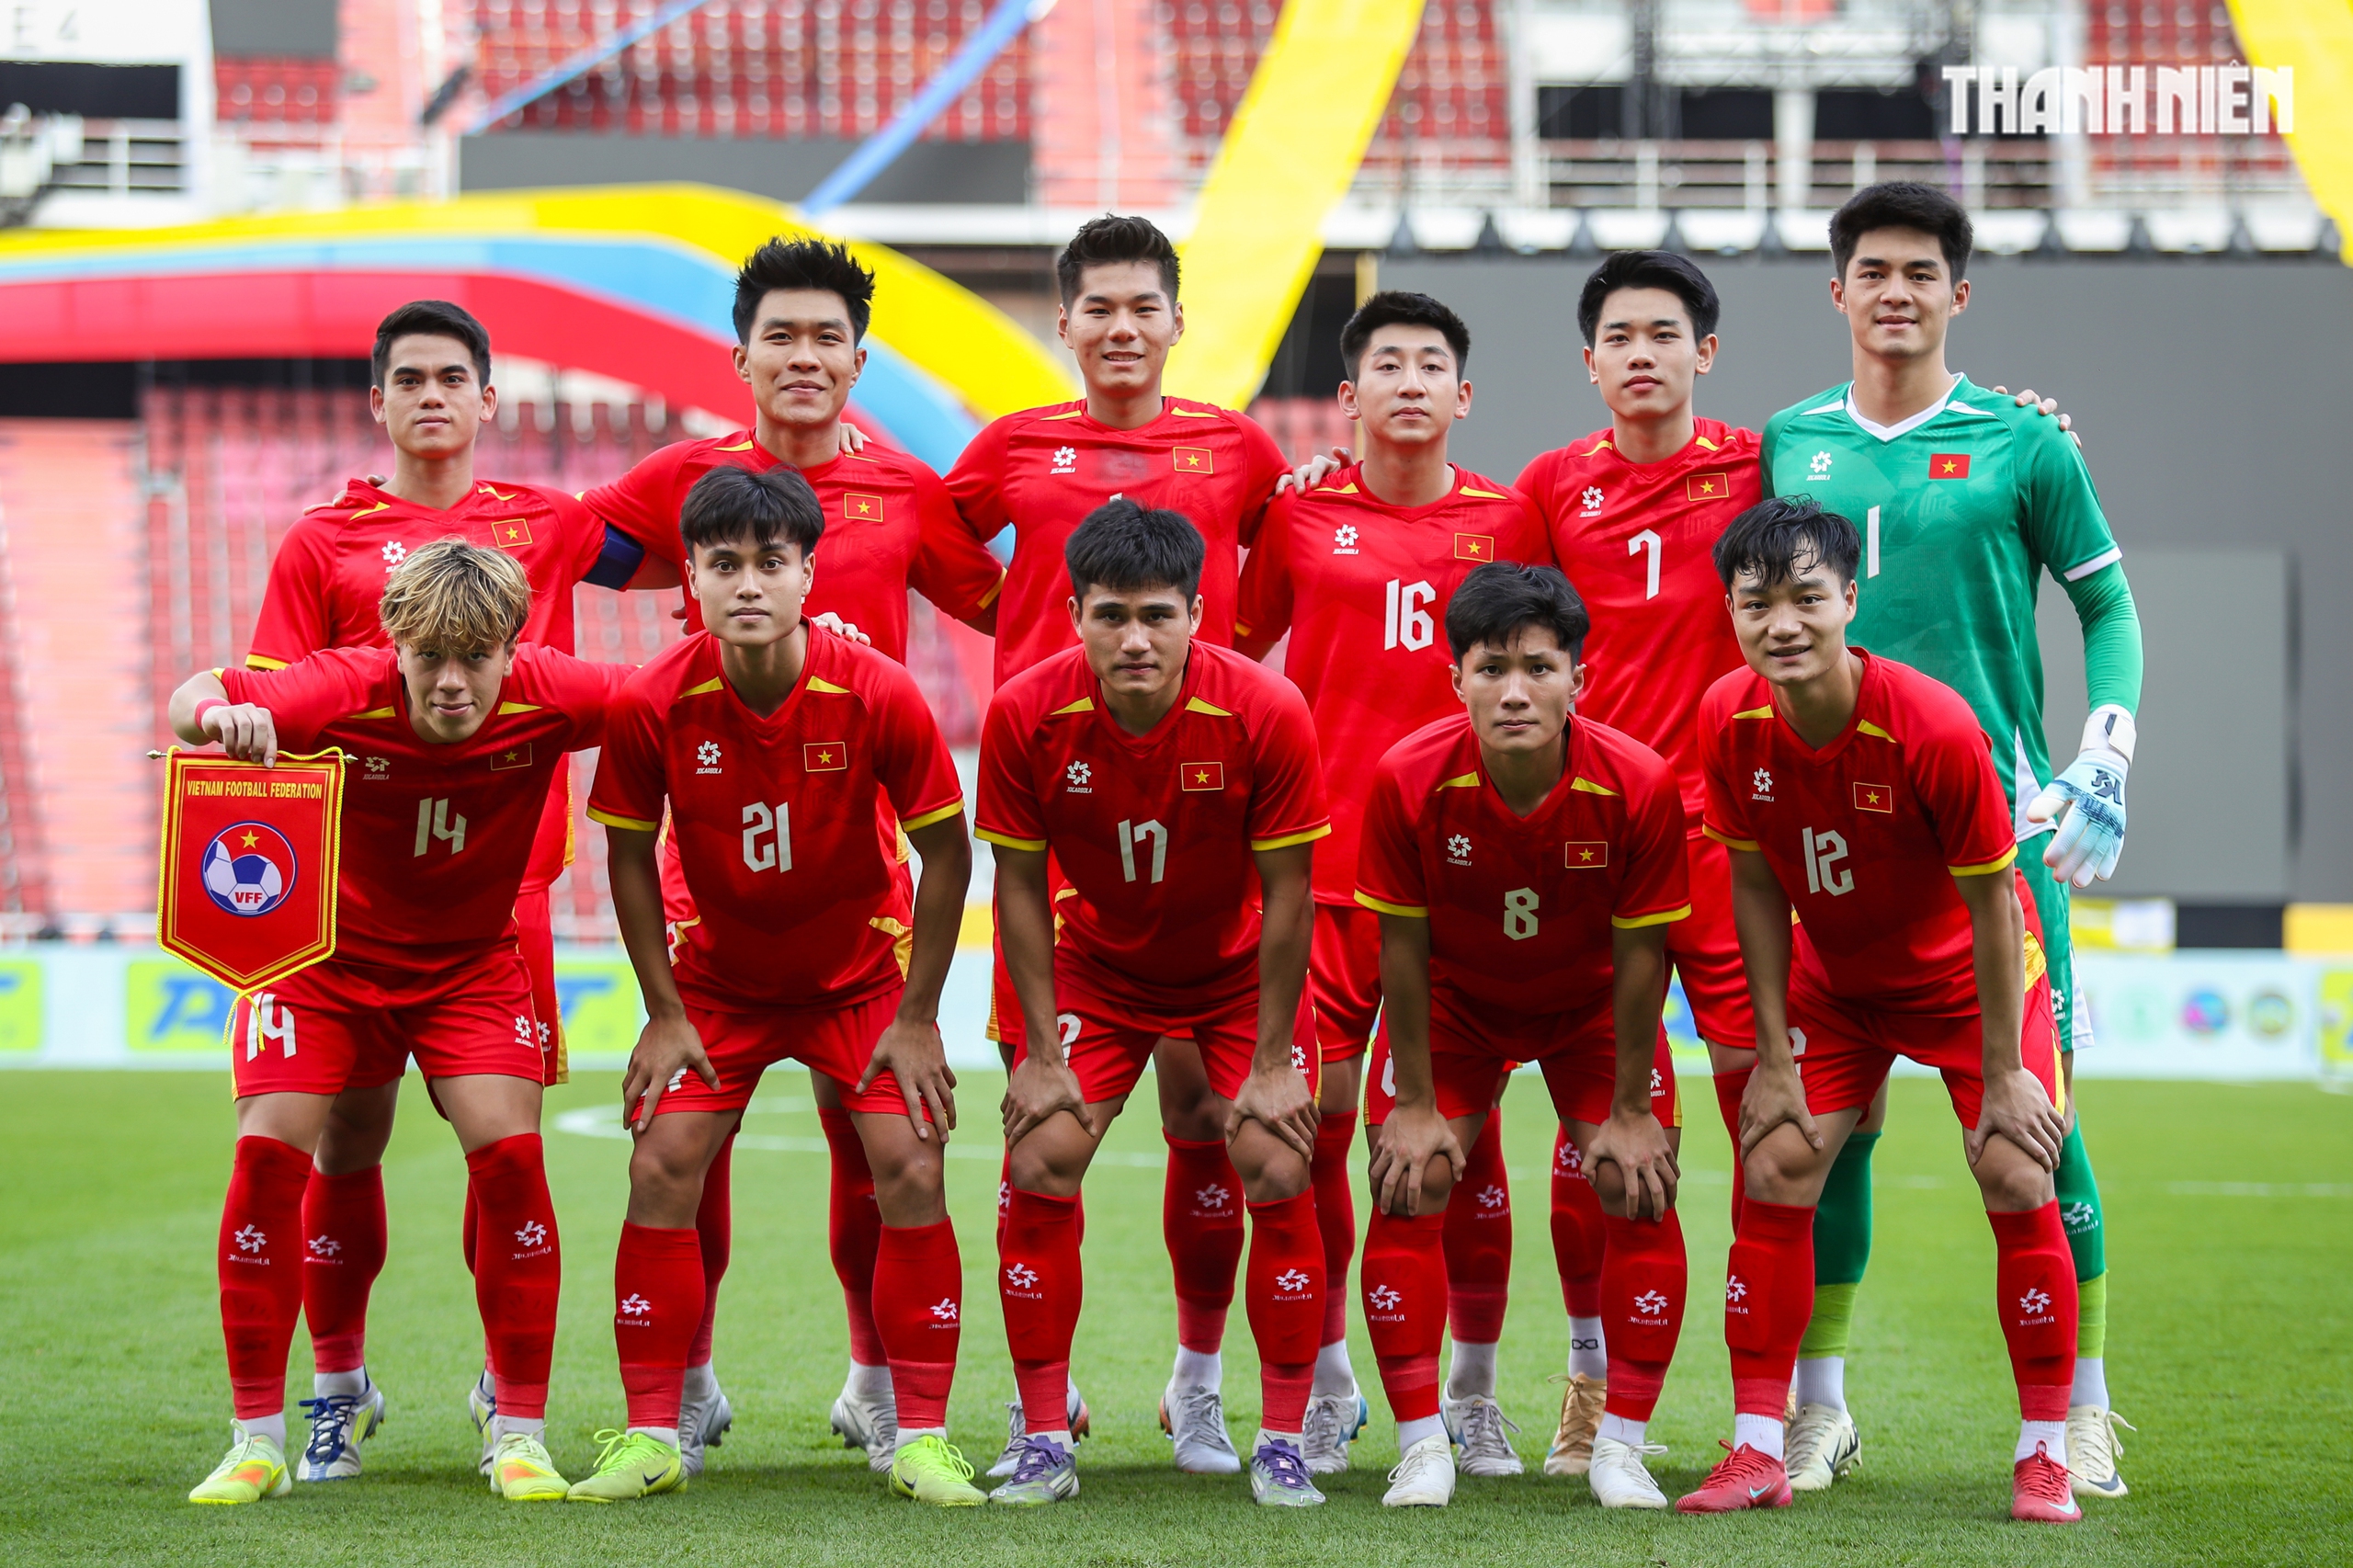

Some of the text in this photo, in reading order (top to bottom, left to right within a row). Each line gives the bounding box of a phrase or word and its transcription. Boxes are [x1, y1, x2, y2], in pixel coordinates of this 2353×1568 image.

[1628, 528, 1662, 600] 7
[1867, 505, 1881, 579] 1
[1384, 578, 1437, 653] 16
[187, 780, 322, 799] VIETNAM FOOTBALL FEDERATION
[414, 797, 468, 858] 14
[742, 801, 792, 874] 21
[1118, 818, 1167, 884] 17
[1802, 826, 1855, 897] 12
[234, 892, 263, 903] VFF
[1503, 886, 1540, 941] 8
[246, 991, 297, 1062] 14
